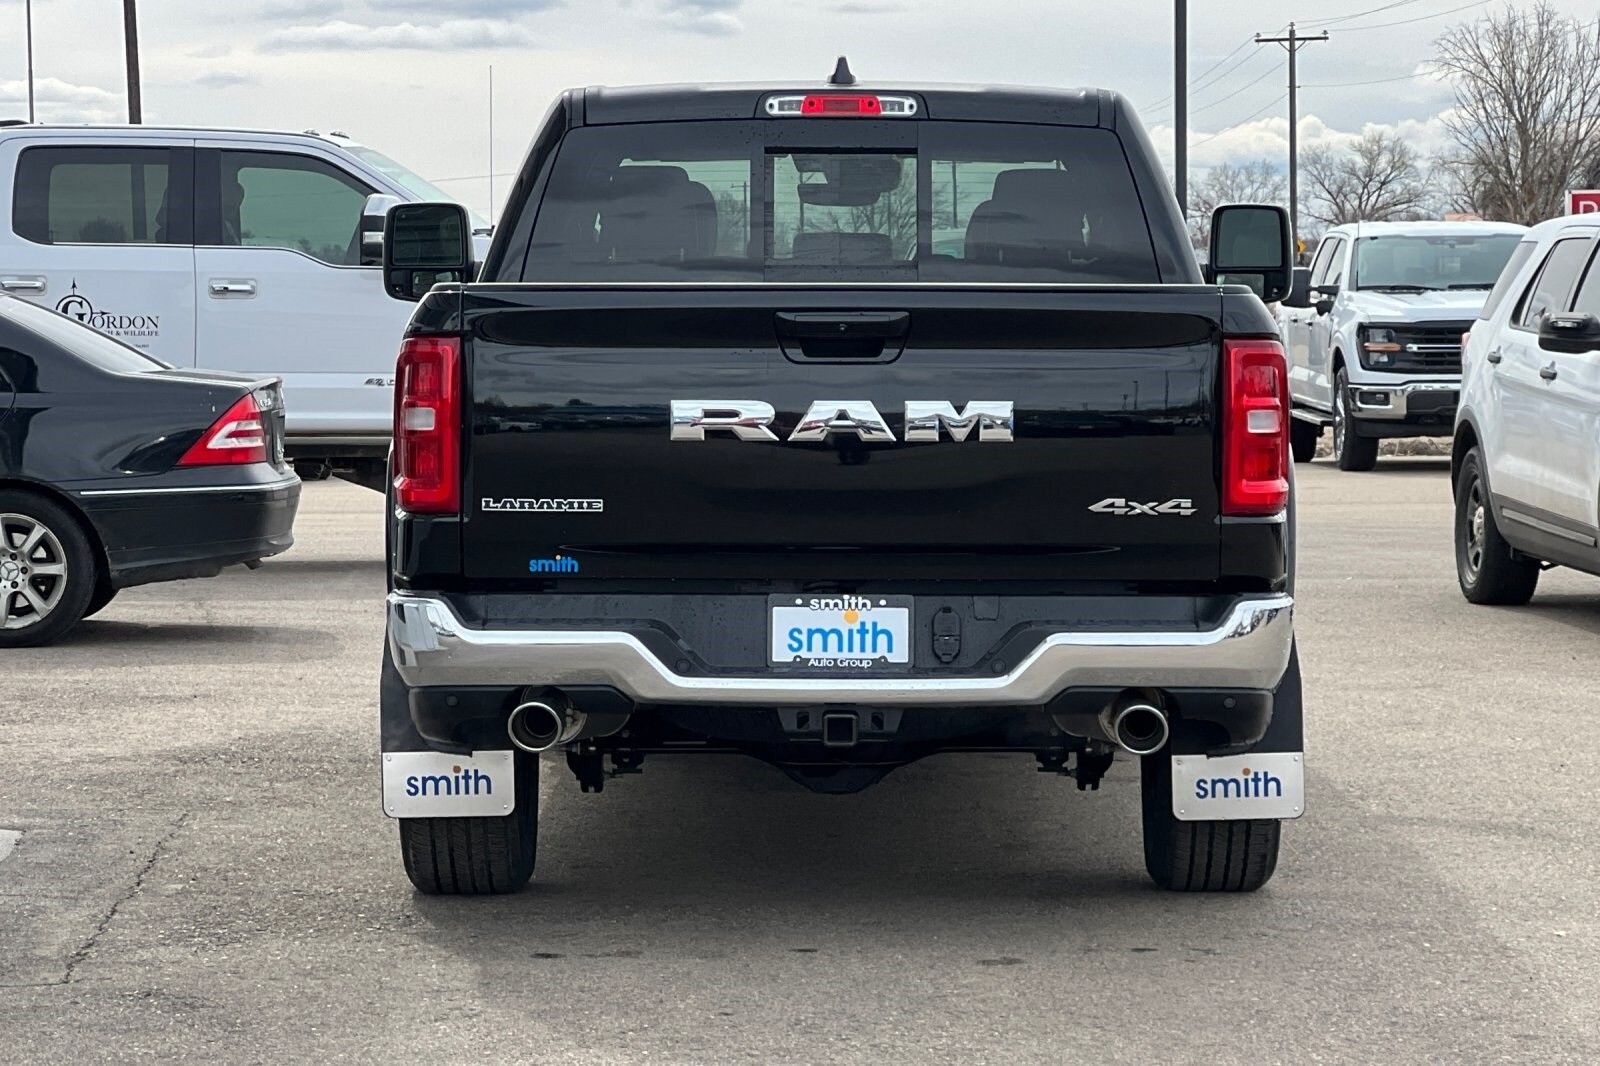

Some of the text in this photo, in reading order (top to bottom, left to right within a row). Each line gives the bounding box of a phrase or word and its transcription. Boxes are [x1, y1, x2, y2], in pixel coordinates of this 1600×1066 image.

[670, 399, 1015, 442] RAM
[481, 498, 604, 512] LARAMIE
[529, 554, 580, 573] smith
[809, 594, 872, 611] smith
[787, 609, 893, 653] smith
[808, 658, 873, 669] Auto Group
[406, 765, 492, 796] smith
[1195, 768, 1282, 799] smith
